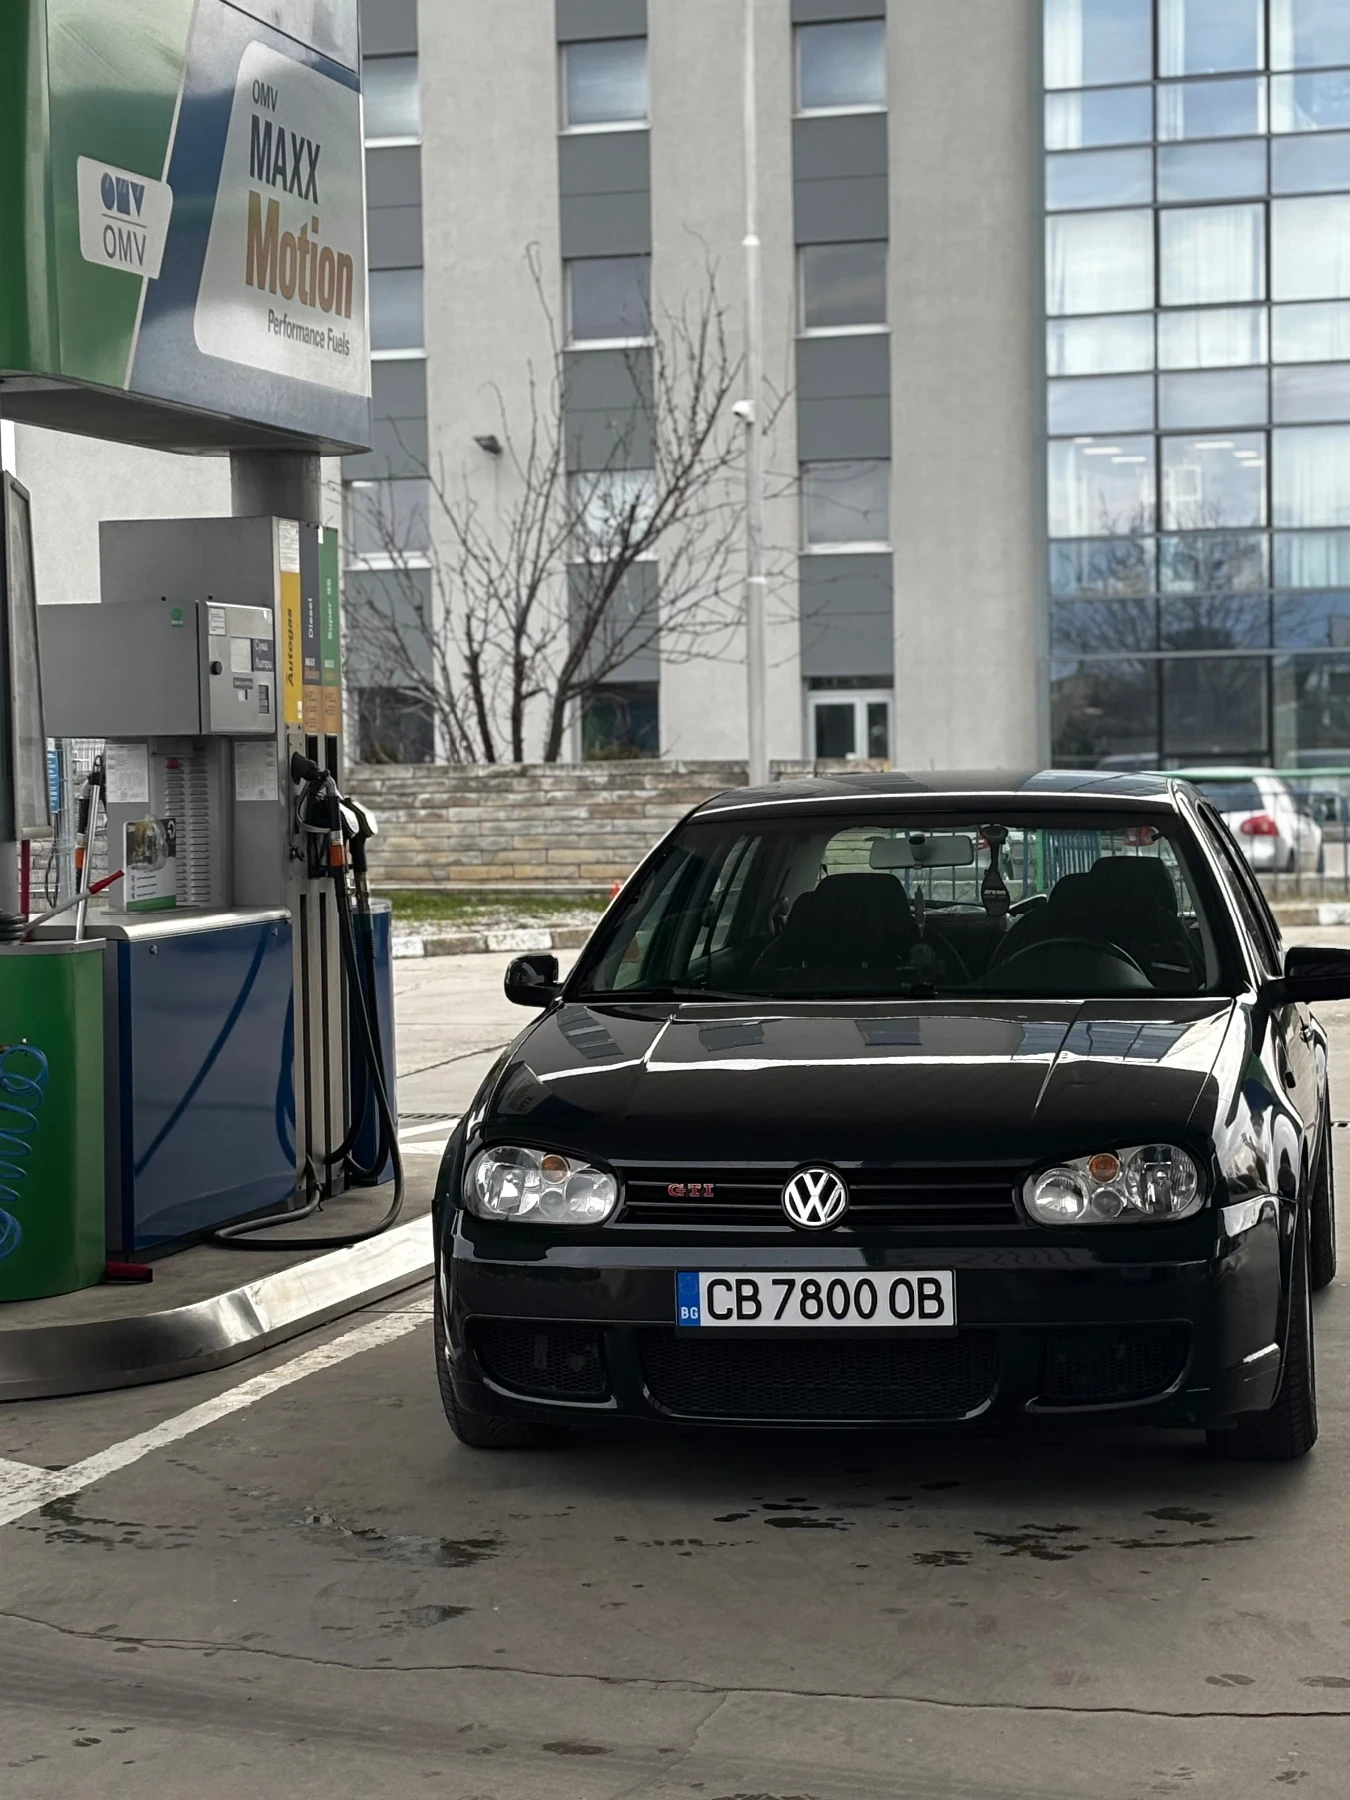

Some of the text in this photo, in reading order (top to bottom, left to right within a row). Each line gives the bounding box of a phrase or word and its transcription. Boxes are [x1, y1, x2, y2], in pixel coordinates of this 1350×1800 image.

[252, 79, 278, 112] OMV
[250, 114, 321, 204] MAXX
[103, 224, 147, 266] OMV
[245, 189, 354, 319] Motion
[267, 308, 350, 356] Performance Fuels
[307, 597, 315, 639] Diesel
[285, 608, 294, 687] Autogas
[667, 1183, 715, 1198] GTI
[681, 1307, 698, 1320] BG
[706, 1277, 945, 1320] CB 7800 OB
